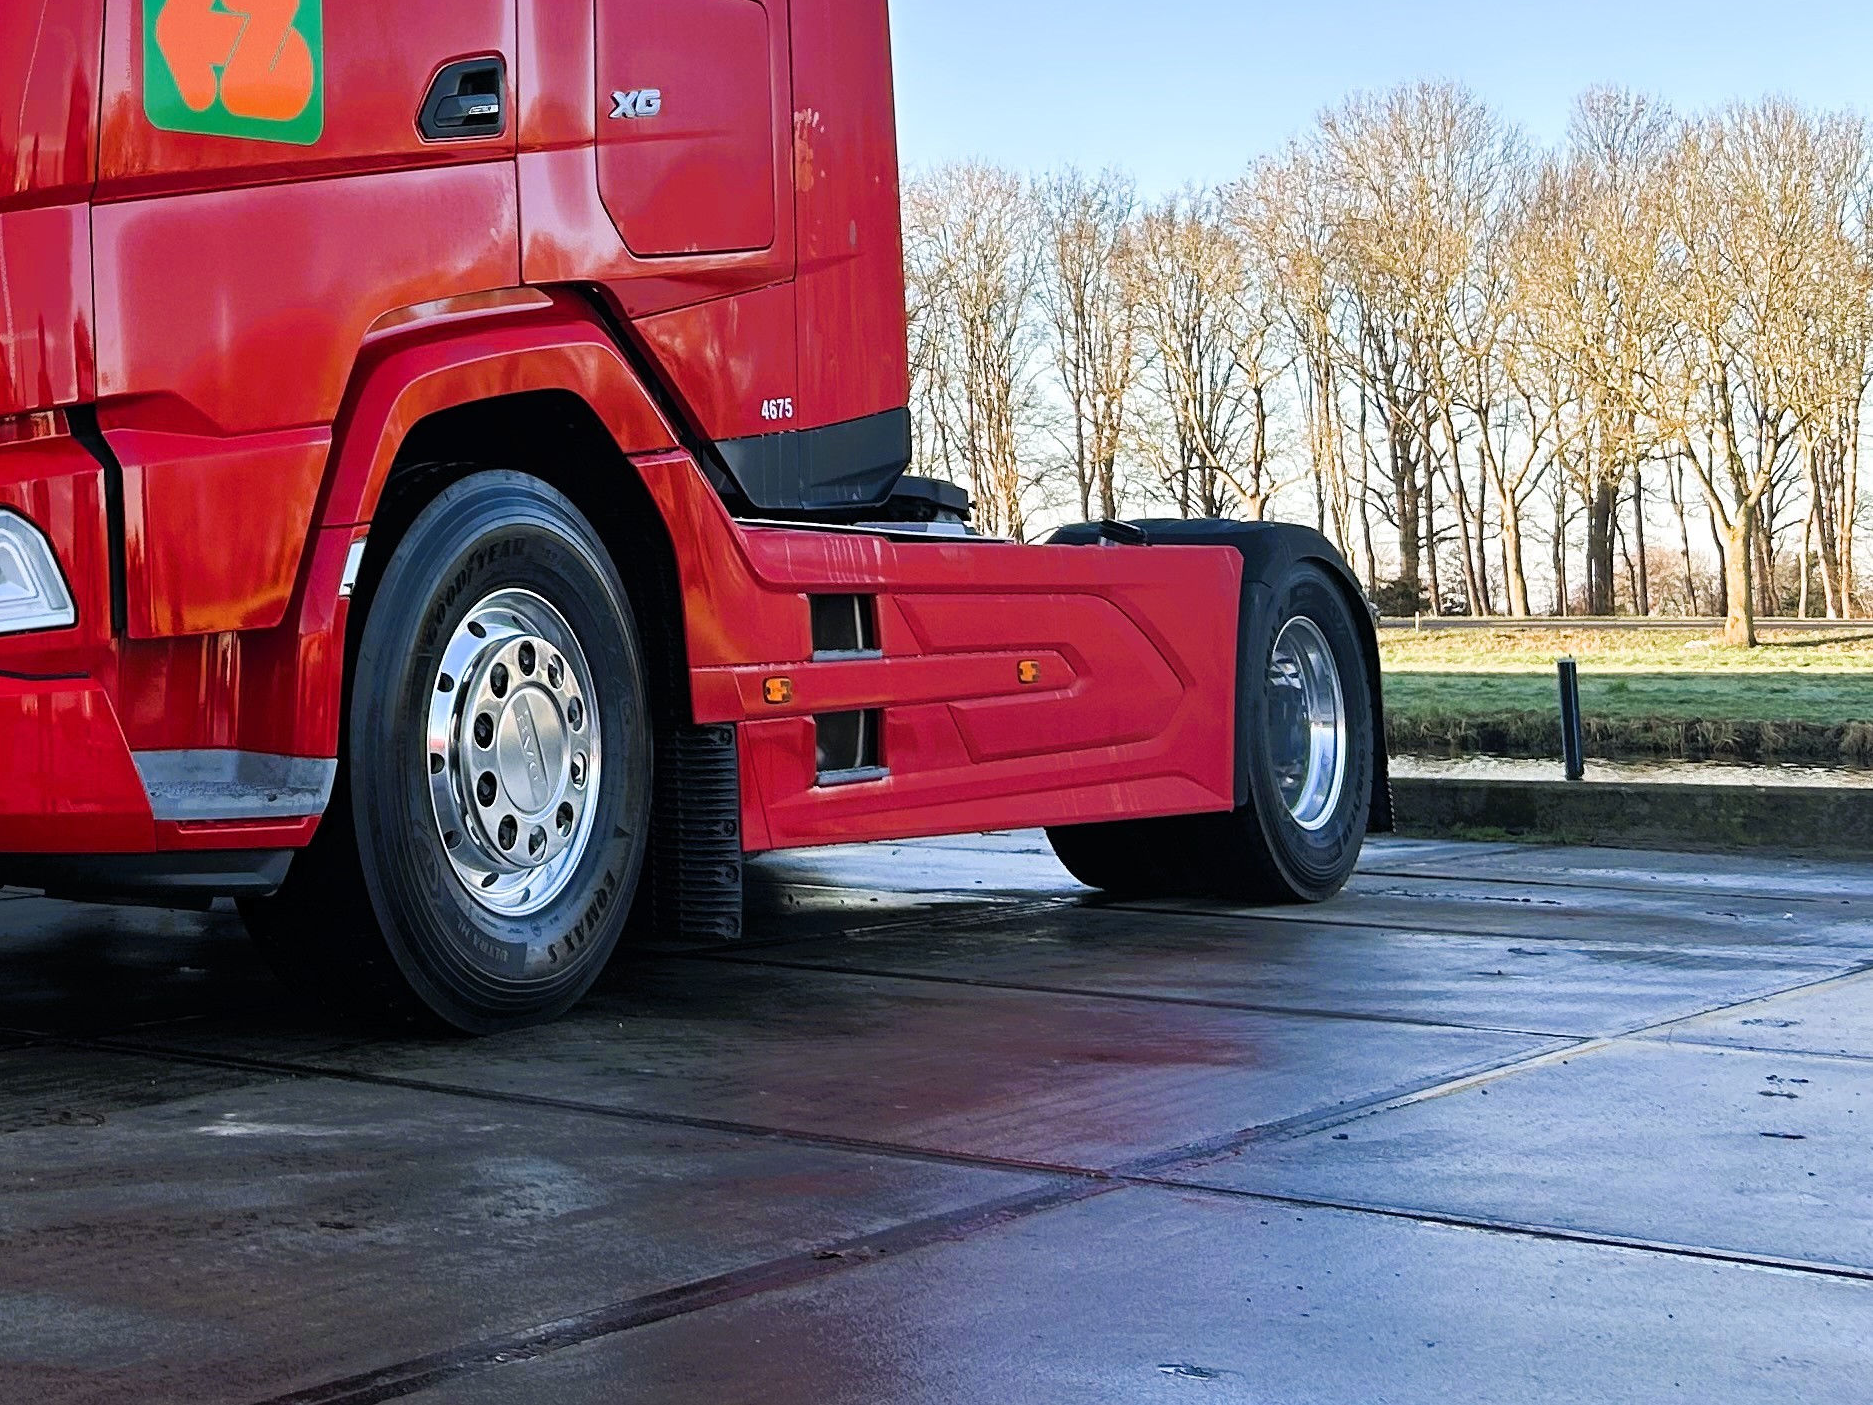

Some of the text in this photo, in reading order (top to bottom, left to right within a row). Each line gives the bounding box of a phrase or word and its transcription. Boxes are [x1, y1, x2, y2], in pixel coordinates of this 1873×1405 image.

[608, 88, 662, 119] XG
[760, 396, 794, 421] 4675
[426, 536, 527, 646] GOODYEAR
